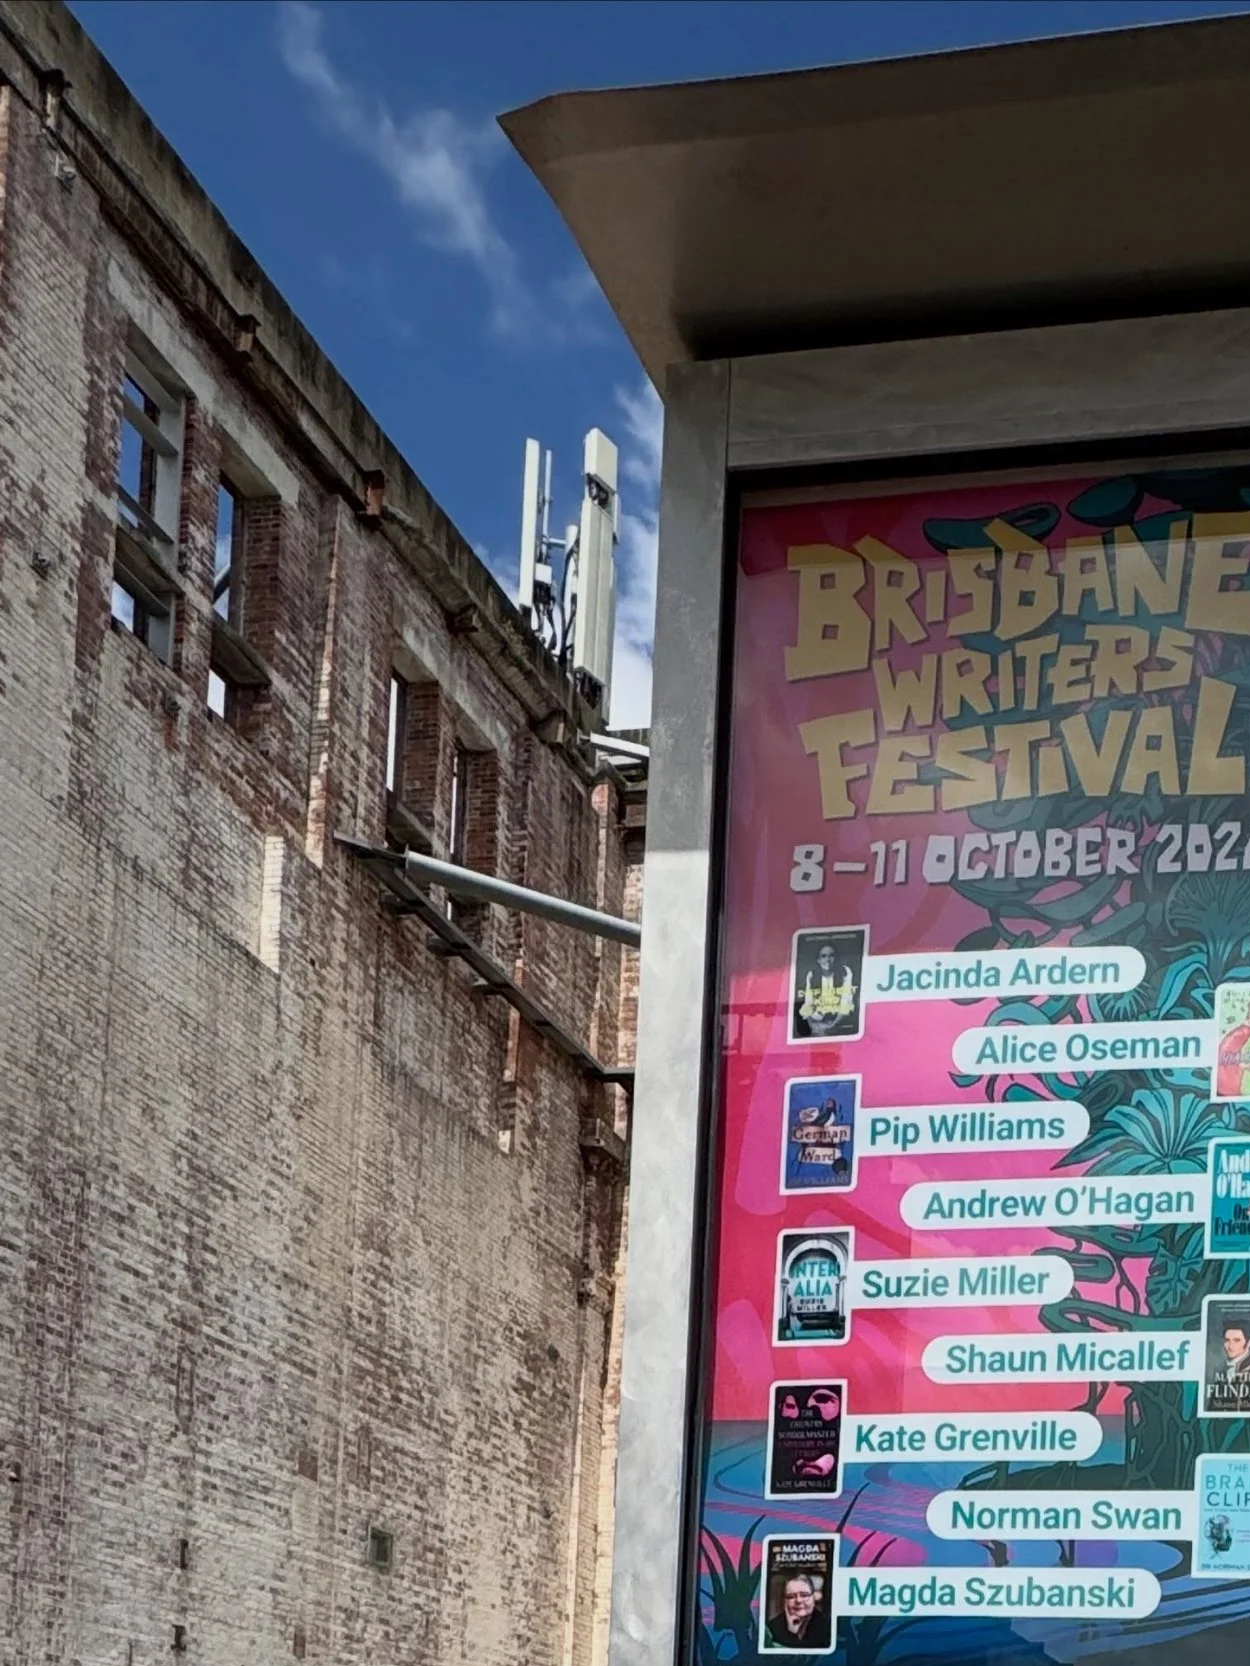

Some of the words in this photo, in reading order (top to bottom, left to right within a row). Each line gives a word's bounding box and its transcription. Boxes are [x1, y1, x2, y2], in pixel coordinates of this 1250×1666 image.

[873, 624, 1197, 732] WRITERS
[798, 676, 1247, 820] FESTIVAL
[922, 828, 1142, 884] OCTOBER
[878, 960, 1000, 991] Jacinda
[1010, 957, 1119, 985] Ardern
[976, 1035, 1057, 1064] Alice
[1066, 1034, 1200, 1061] Oseman
[871, 1116, 920, 1151] Pip
[929, 1112, 1064, 1143] Williams
[924, 1189, 1046, 1219] Andrew
[1055, 1186, 1194, 1221] O'Hagan
[794, 1280, 832, 1296] ALIA
[863, 1269, 948, 1298] Suzie
[959, 1266, 1049, 1295] Miller
[947, 1344, 1046, 1373] Shaun
[1057, 1340, 1190, 1371] Micallef
[856, 1425, 925, 1452] Kate
[935, 1421, 1076, 1451] Grenville
[1227, 1463, 1249, 1473] THE
[952, 1501, 1081, 1529] Norman
[1092, 1501, 1181, 1529] Swan
[783, 1544, 820, 1553] MAGDA
[849, 1576, 955, 1614] Magda
[964, 1577, 1134, 1607] Szubanski
